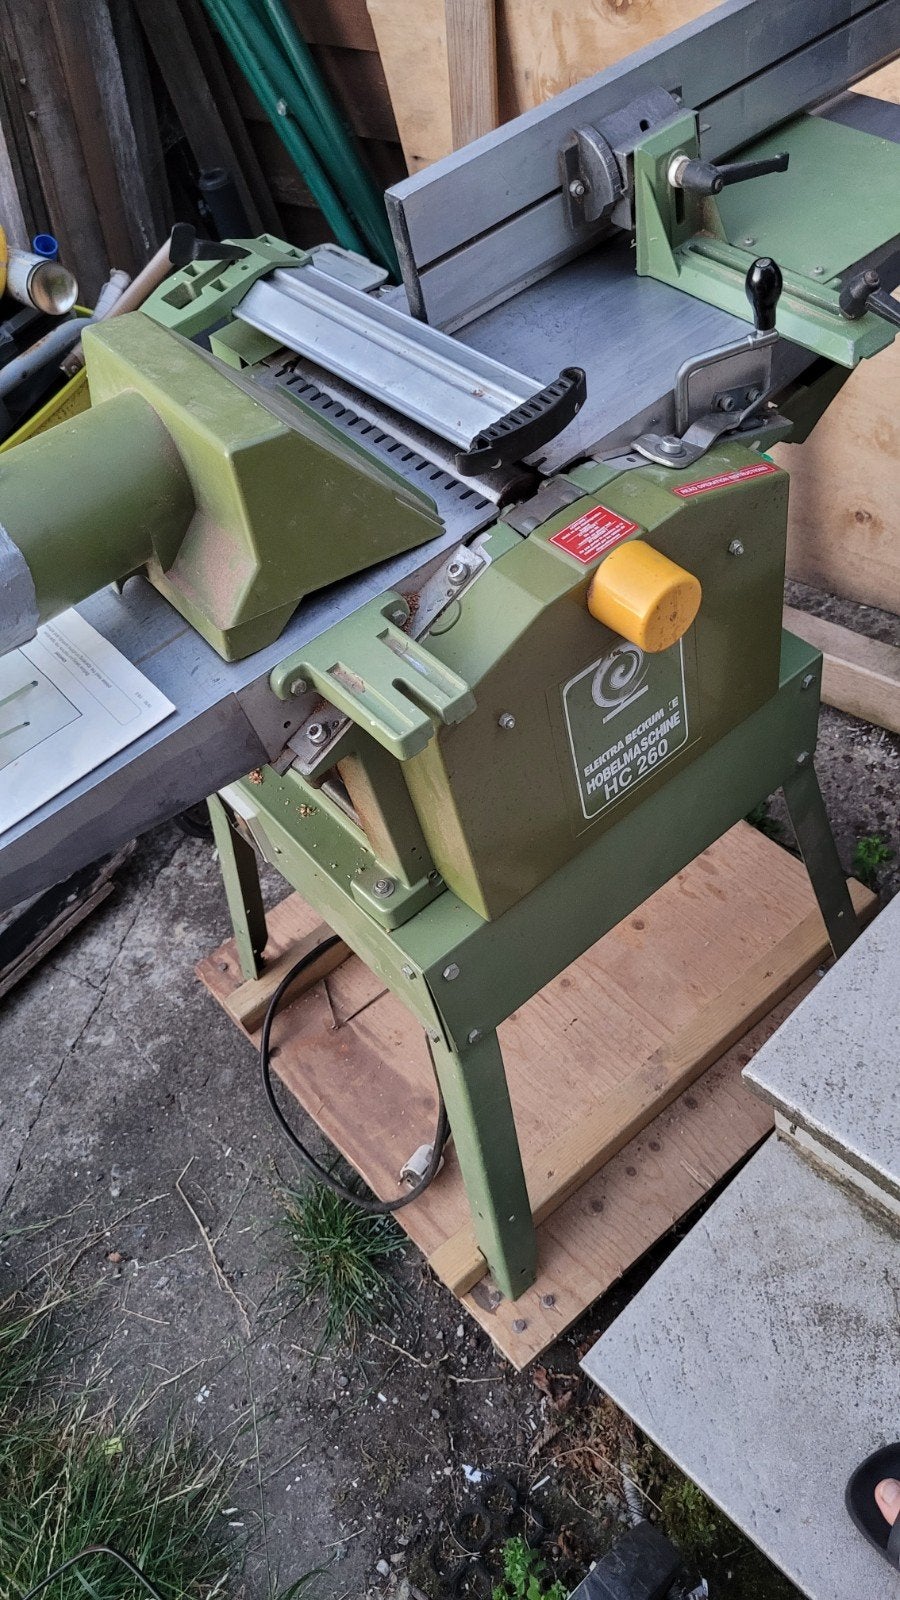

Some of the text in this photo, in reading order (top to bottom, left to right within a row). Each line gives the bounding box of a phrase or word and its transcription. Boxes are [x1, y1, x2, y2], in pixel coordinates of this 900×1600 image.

[584, 740, 625, 777] ELEKTRA
[625, 708, 665, 745] BECKUM
[586, 711, 681, 795] HOBELMASCHINE
[604, 739, 668, 800] HC 260
